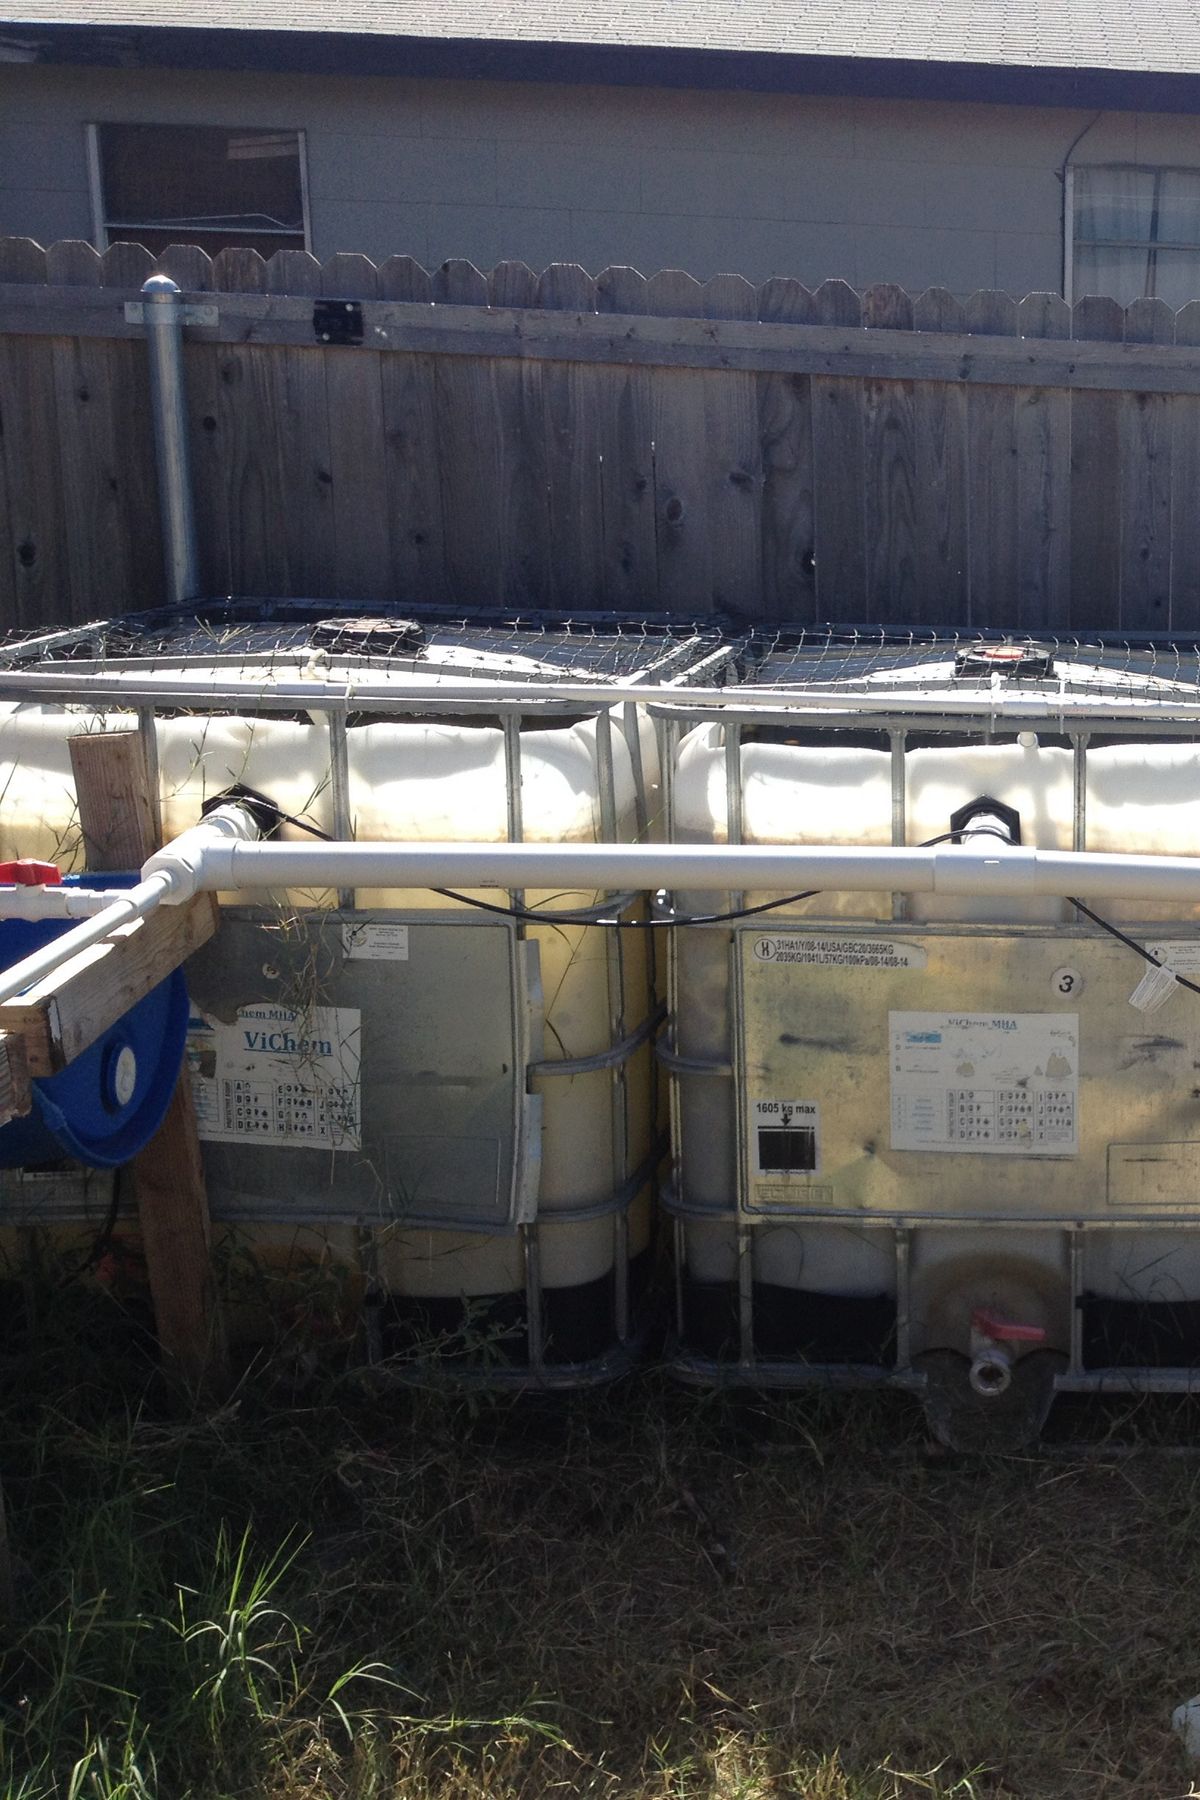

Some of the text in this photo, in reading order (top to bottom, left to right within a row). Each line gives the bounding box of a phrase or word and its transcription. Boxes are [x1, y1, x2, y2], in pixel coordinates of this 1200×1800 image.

[1058, 974, 1075, 993] 3
[243, 1030, 333, 1055] ViChem
[756, 1102, 816, 1116] 1605 kg max
